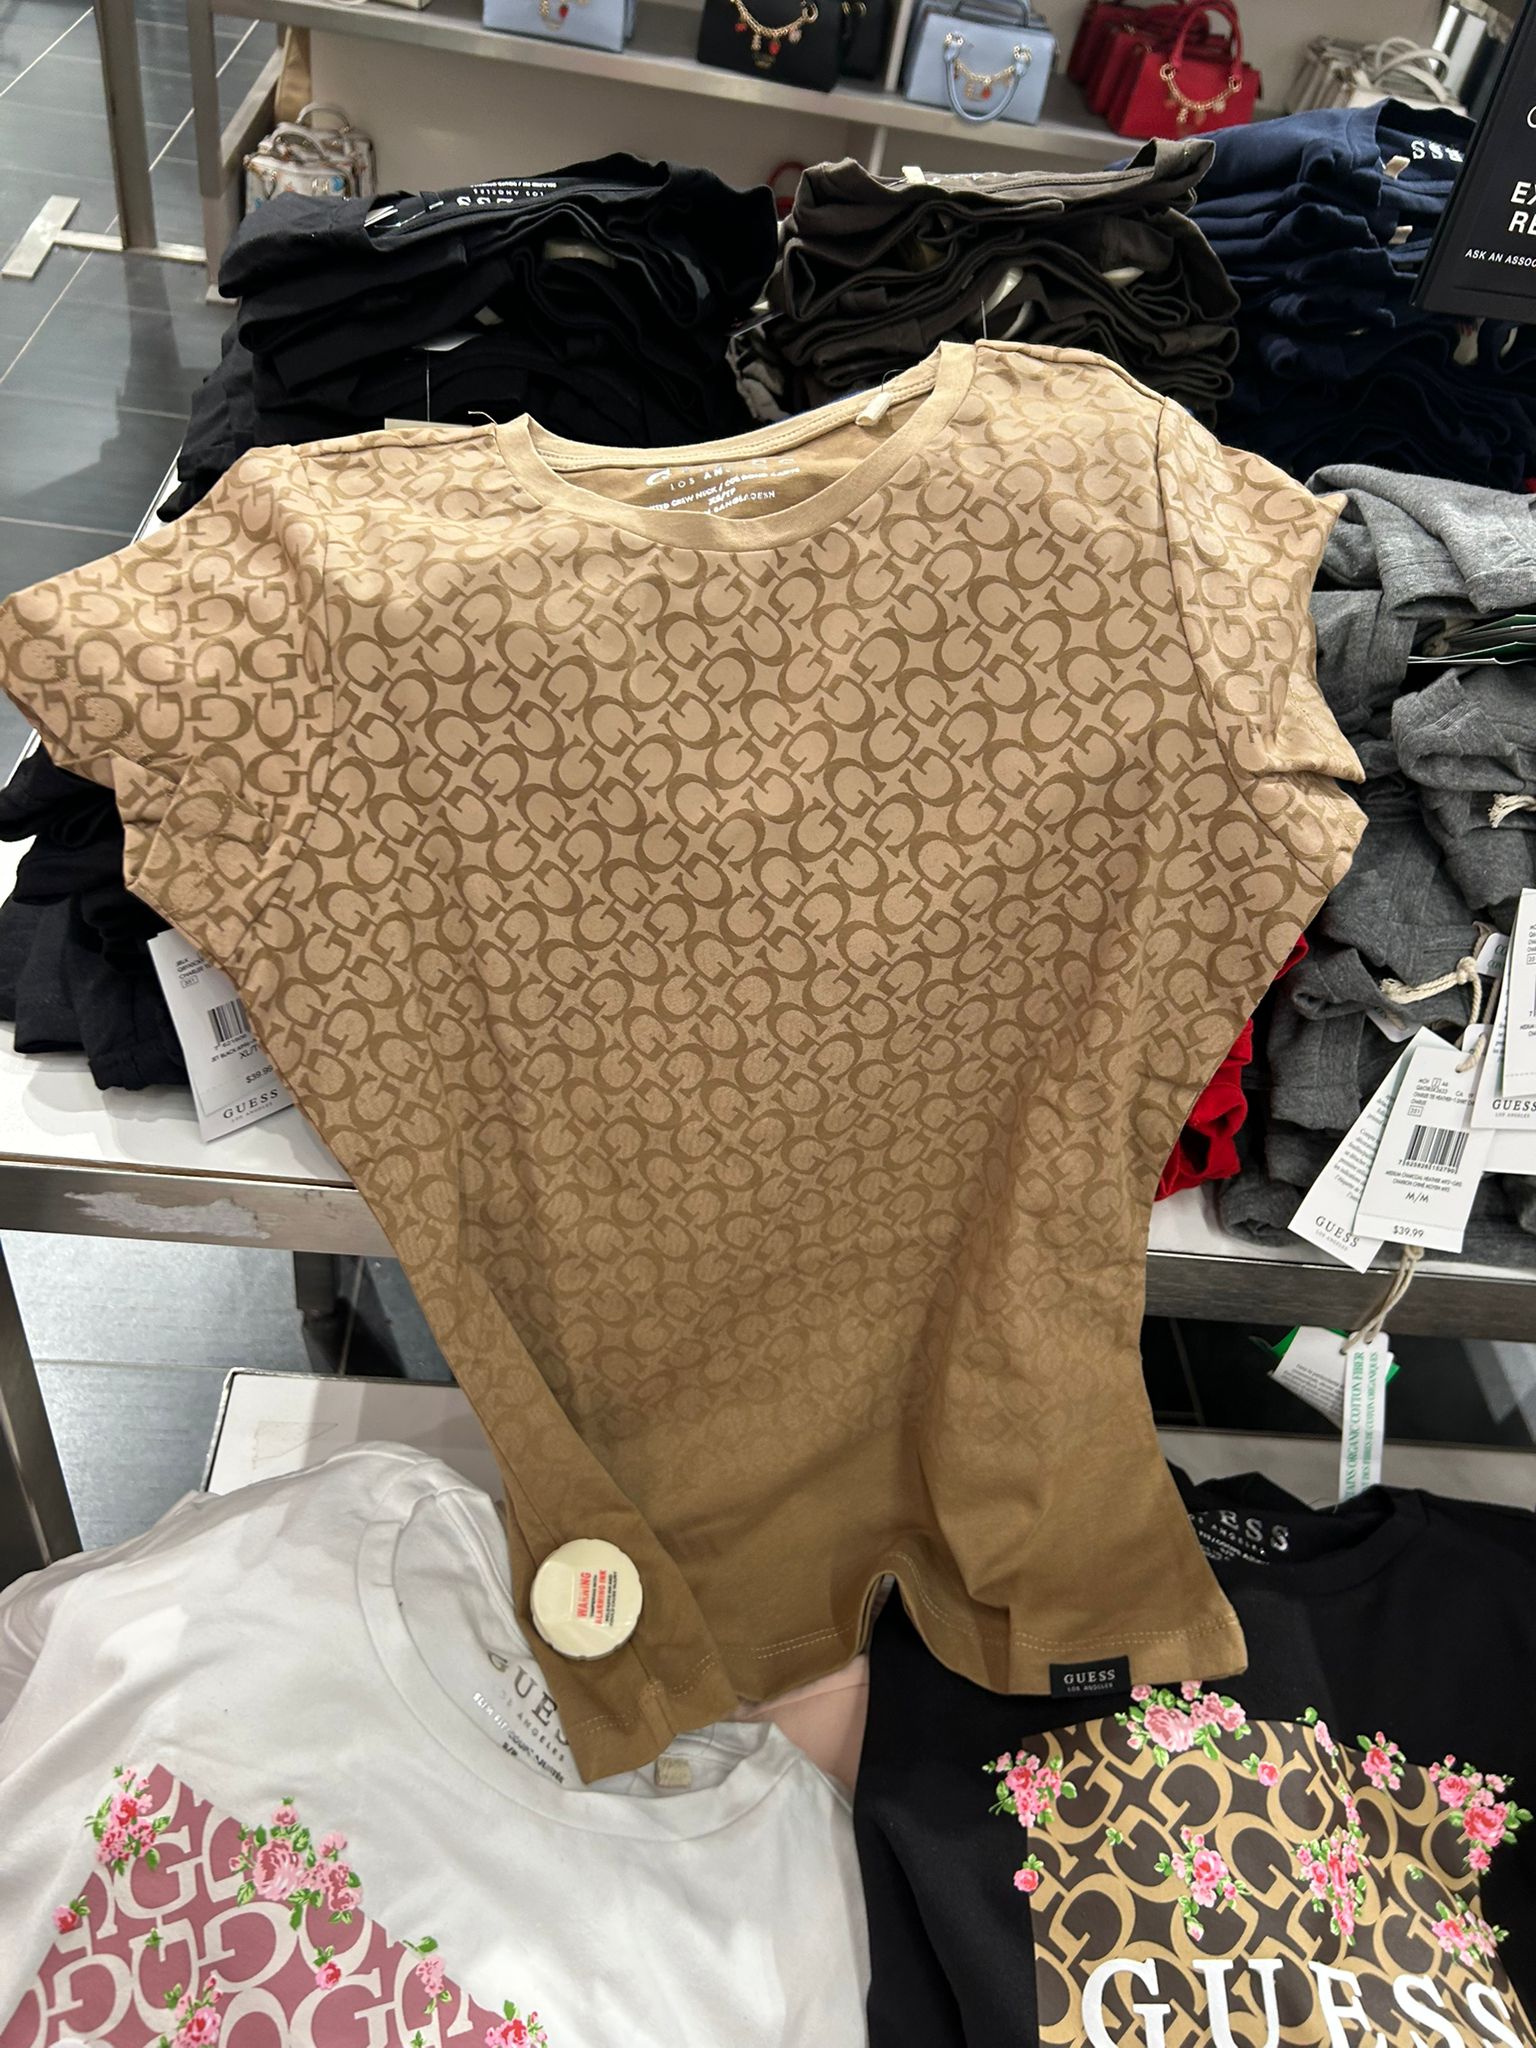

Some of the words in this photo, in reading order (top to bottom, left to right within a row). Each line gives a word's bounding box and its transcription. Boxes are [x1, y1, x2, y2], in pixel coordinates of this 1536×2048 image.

[1465, 248, 1487, 260] ASK
[1488, 252, 1503, 262] AN
[670, 477, 695, 491] LOS
[223, 1089, 278, 1118] GUESS
[1492, 1099, 1536, 1112] GUESS
[1405, 1192, 1429, 1203] M/M
[1315, 1215, 1360, 1247] GUESS
[1393, 1225, 1424, 1238] $39.99
[577, 1572, 591, 1617] WARNING
[1063, 1669, 1116, 1685] GUESS
[488, 1651, 569, 1745] GUE
[1081, 1957, 1530, 2048] GUESS
